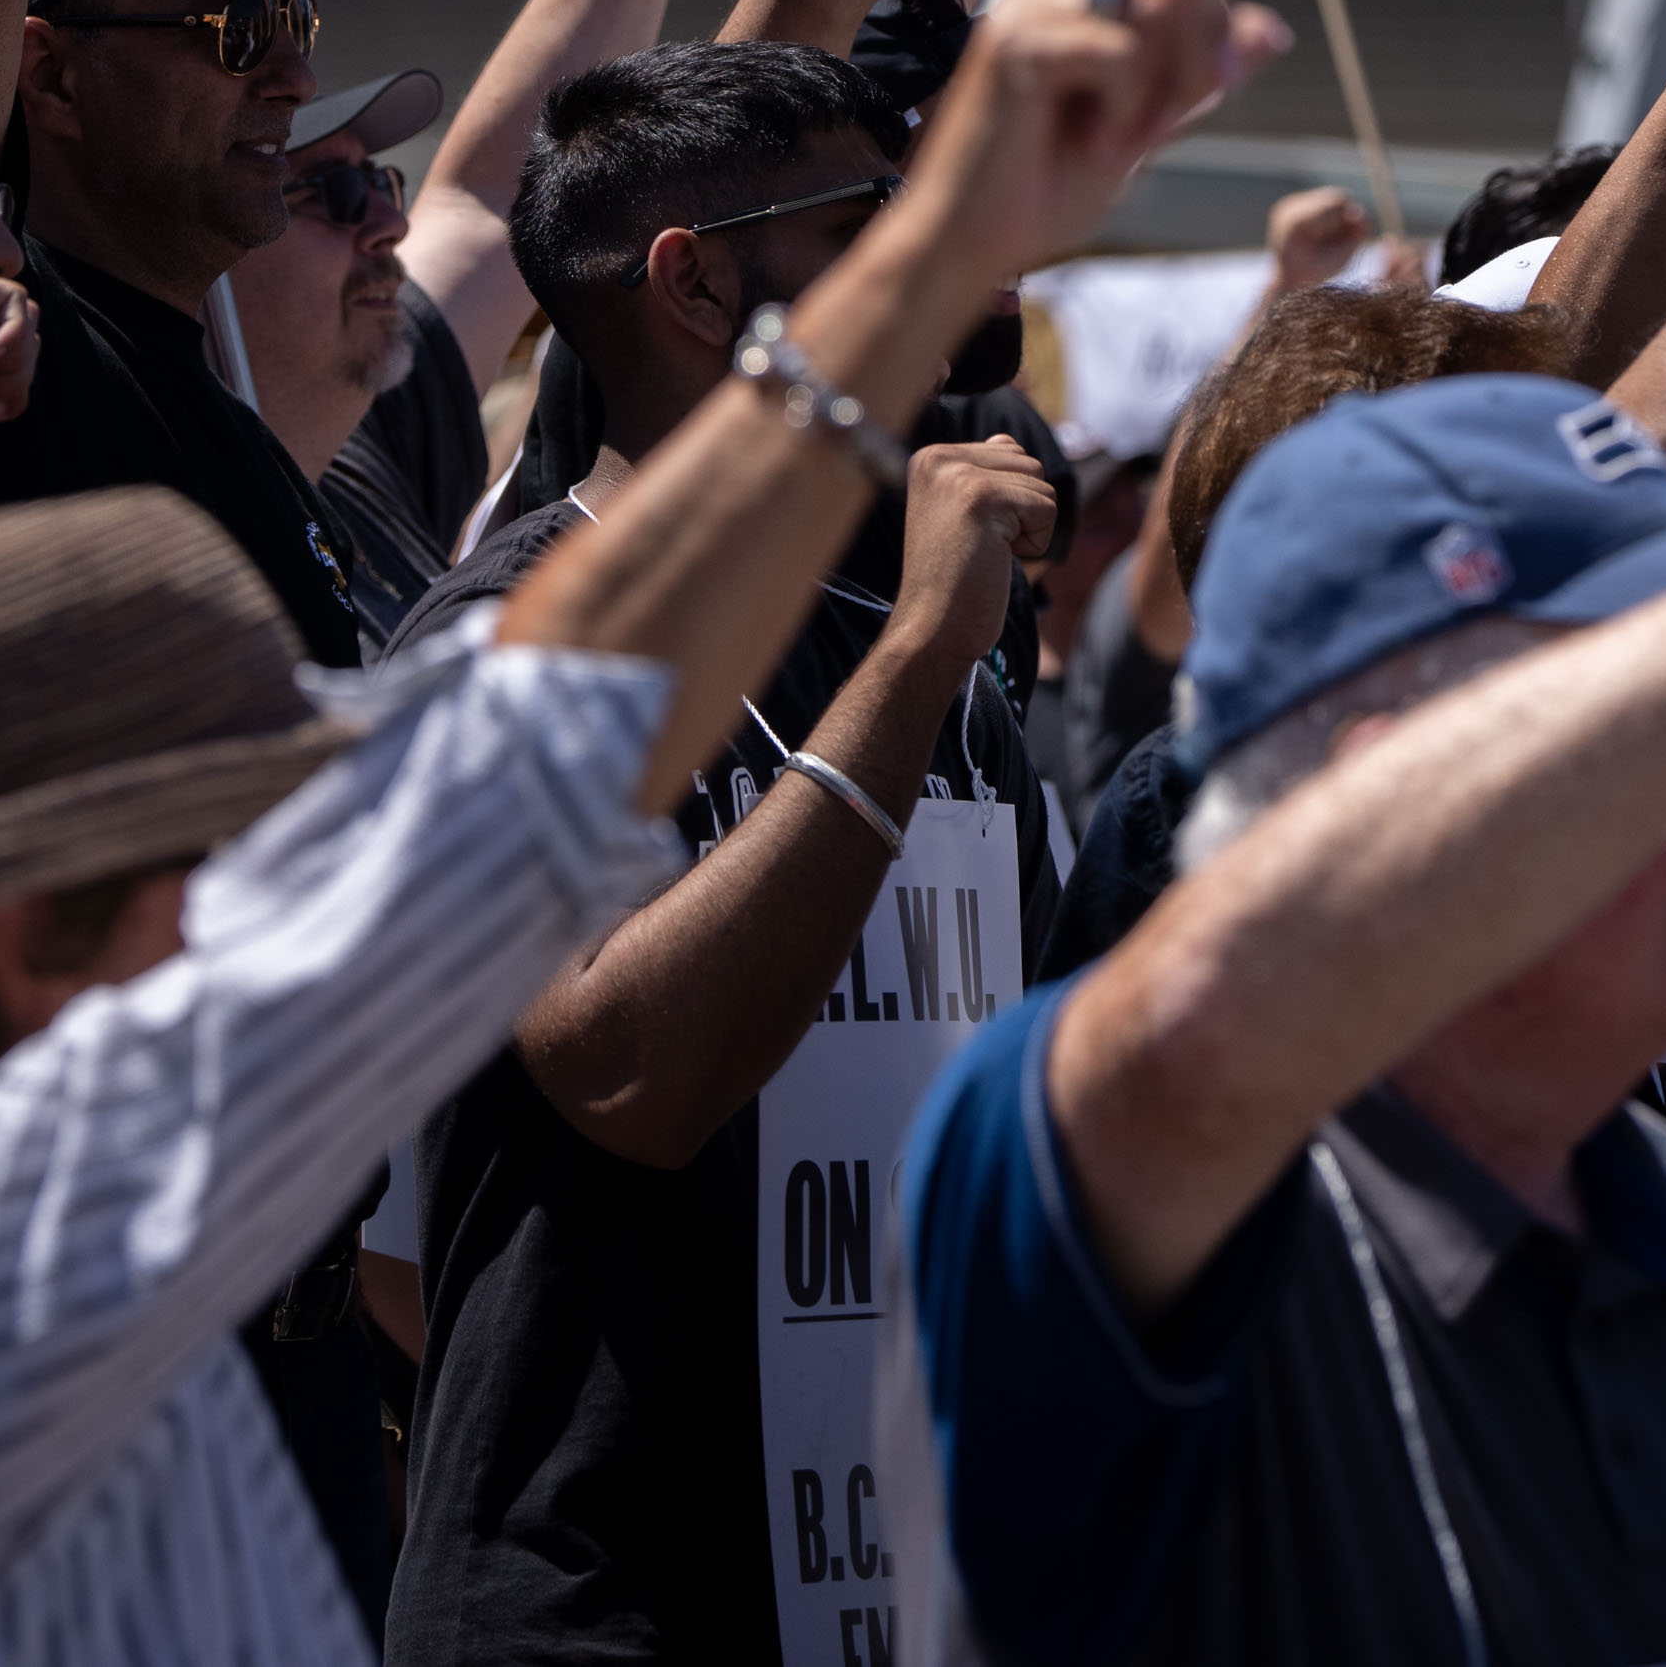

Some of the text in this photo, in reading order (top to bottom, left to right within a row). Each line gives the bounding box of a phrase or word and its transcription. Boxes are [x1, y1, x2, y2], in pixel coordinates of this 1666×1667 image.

[814, 886, 997, 1023] .L.W.U.
[784, 1158, 873, 1309] ON
[792, 1463, 896, 1584] B.C.
